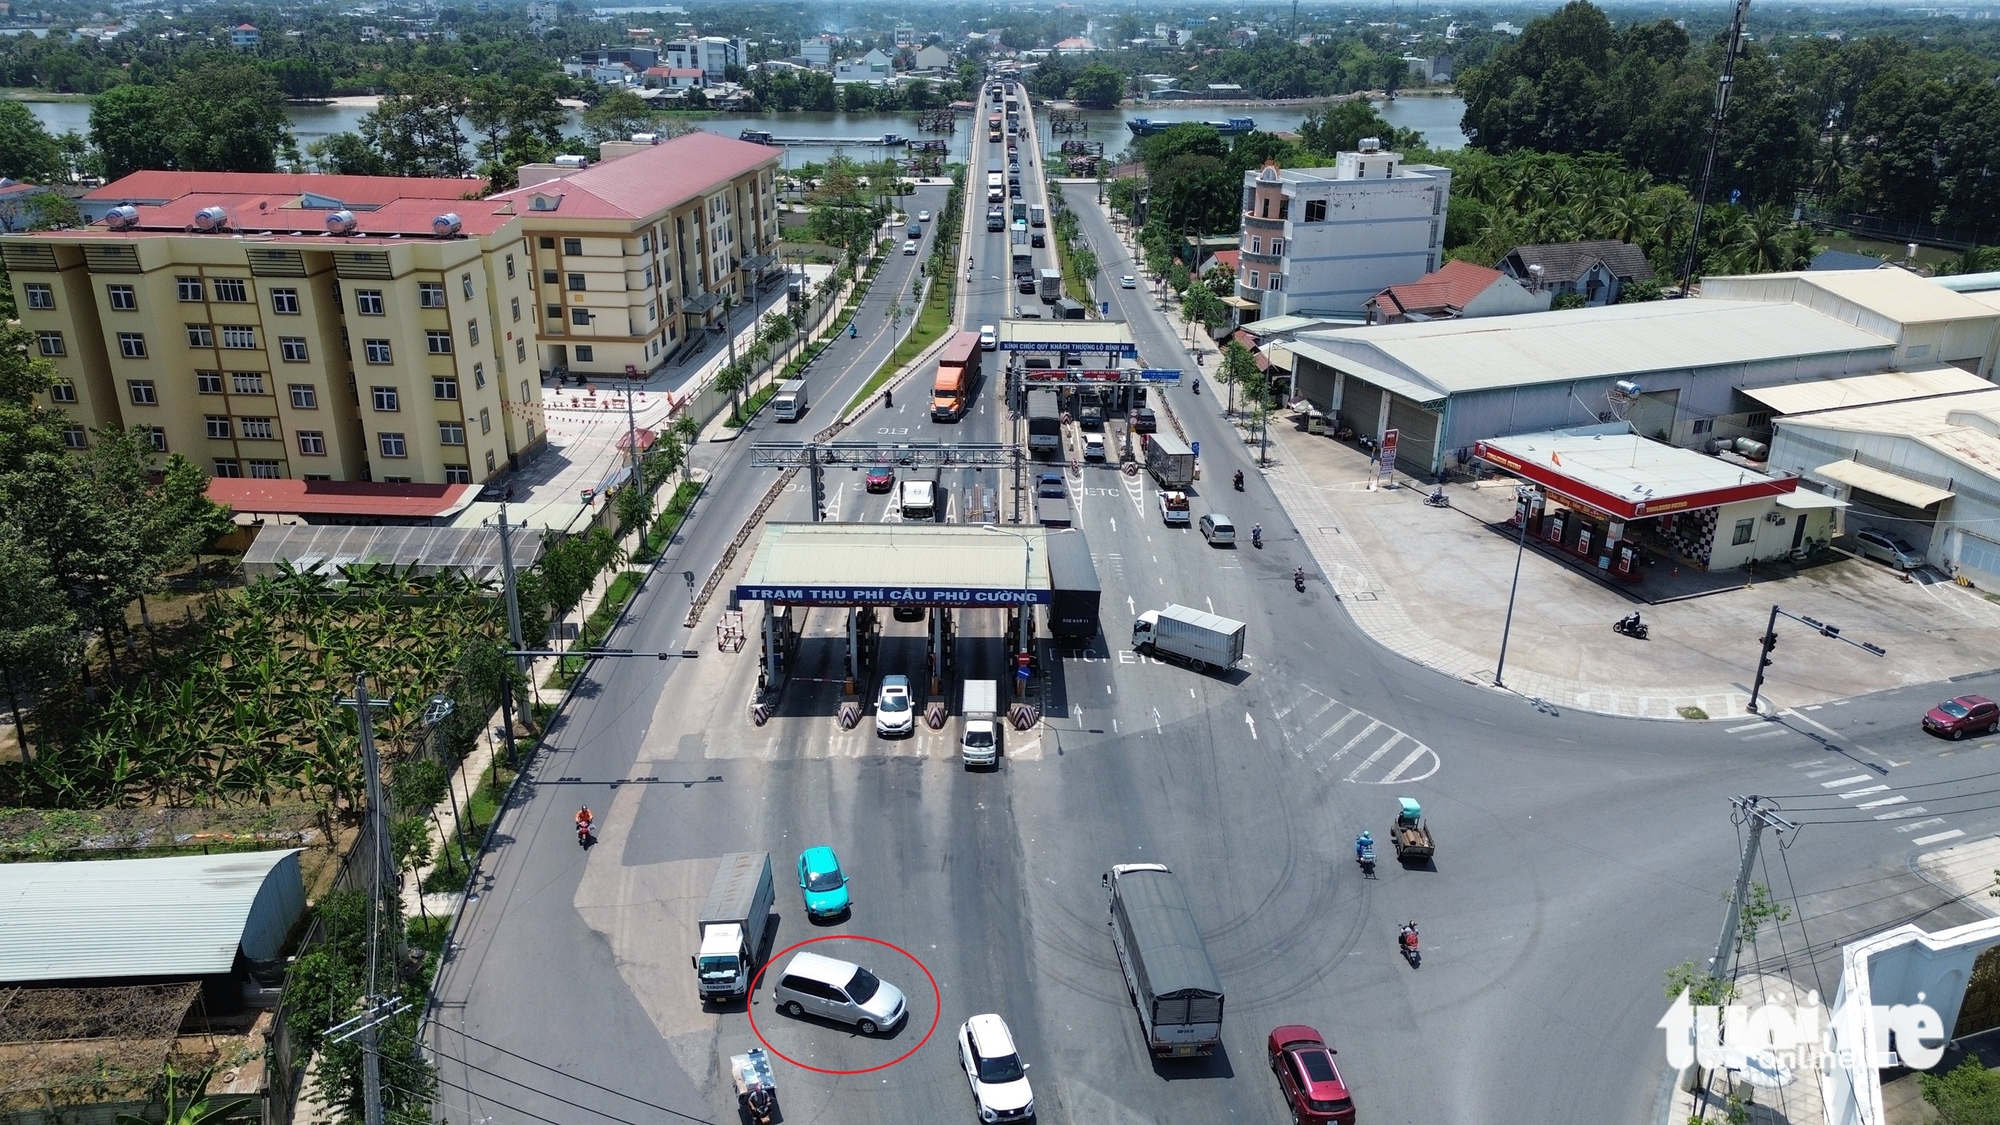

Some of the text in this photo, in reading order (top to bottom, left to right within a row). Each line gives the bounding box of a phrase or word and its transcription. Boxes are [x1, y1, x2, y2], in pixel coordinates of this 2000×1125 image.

[1085, 487, 1119, 497] ETC
[749, 587, 1038, 602] TRẠM THU PHÍ CẦU PHÚ CƯỜNG
